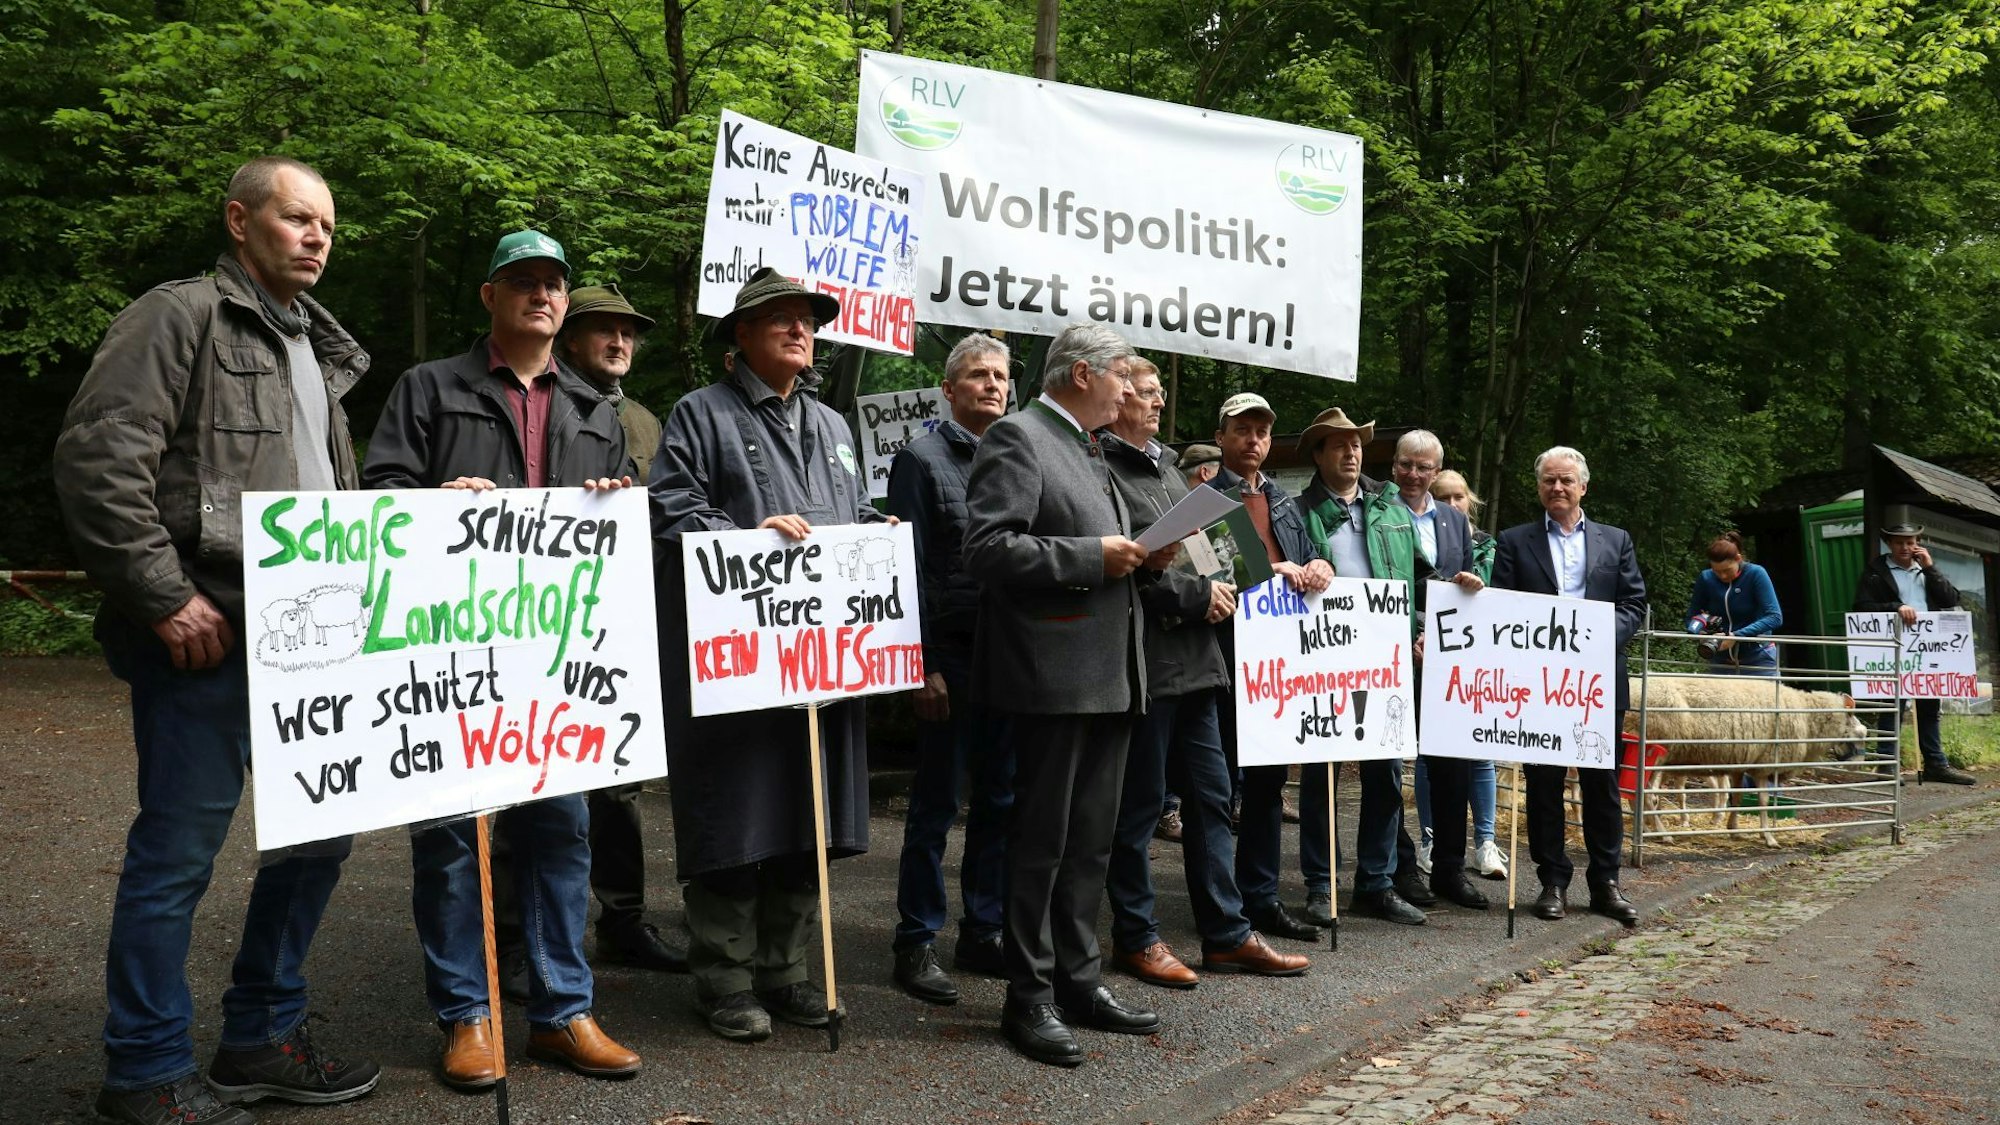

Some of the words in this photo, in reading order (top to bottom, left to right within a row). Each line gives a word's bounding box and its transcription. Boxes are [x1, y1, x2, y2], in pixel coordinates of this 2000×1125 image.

[912, 77, 966, 109] RLV
[724, 121, 791, 174] Keine
[807, 146, 909, 204] Ausreden
[1303, 145, 1347, 174] RLV
[725, 183, 785, 226] mehr:
[789, 192, 919, 257] PROBLEM-
[939, 172, 1286, 268] Wolfspolitik:
[805, 240, 886, 288] WÖLFE
[931, 256, 1069, 317] Jetzt
[1088, 276, 1295, 350] ändern!
[862, 392, 940, 429] Deutsche
[258, 495, 413, 607] Schafe
[447, 492, 618, 557] schützen
[695, 539, 822, 595] Unsere
[362, 558, 607, 677] Landschaft,
[741, 587, 822, 627] Tiere
[844, 575, 904, 626] sind
[1322, 595, 1354, 612] muss
[1364, 582, 1410, 616] Wort
[1848, 614, 1881, 634] Noch
[1298, 613, 1358, 655] halten:
[1436, 608, 1475, 652] Es
[1492, 606, 1592, 653] reicht:
[372, 647, 503, 728] schützt
[564, 661, 628, 704] uns
[1243, 644, 1401, 719] Wolfsmanagement
[1445, 665, 1531, 719] Auffällige
[1543, 667, 1604, 725] Wölfe
[1472, 718, 1562, 751] entnehmen
[295, 756, 362, 803] vor
[390, 724, 443, 778] den
